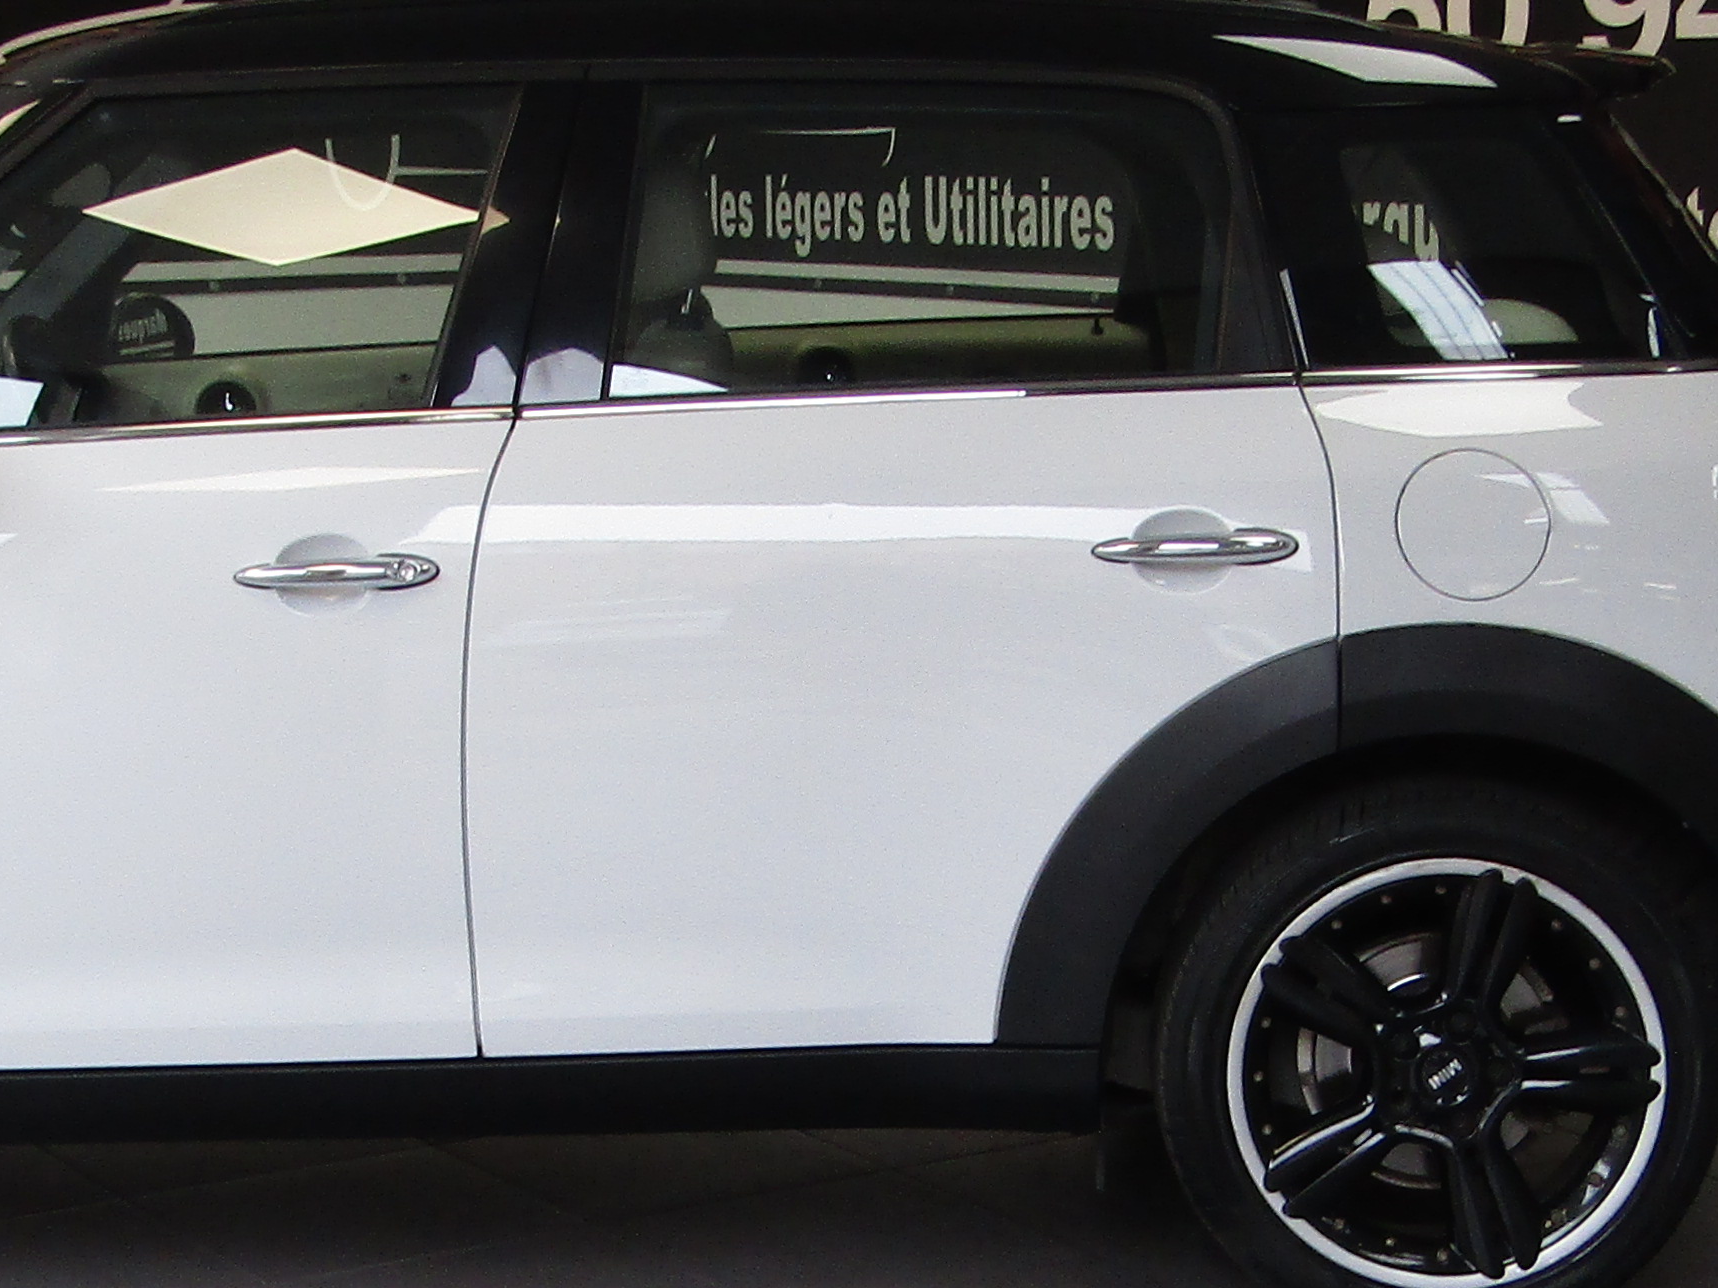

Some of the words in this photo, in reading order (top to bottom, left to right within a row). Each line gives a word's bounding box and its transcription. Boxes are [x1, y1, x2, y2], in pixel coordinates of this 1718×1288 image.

[764, 173, 865, 258] légers
[877, 175, 912, 244] et
[924, 174, 1115, 253] Utilitaires
